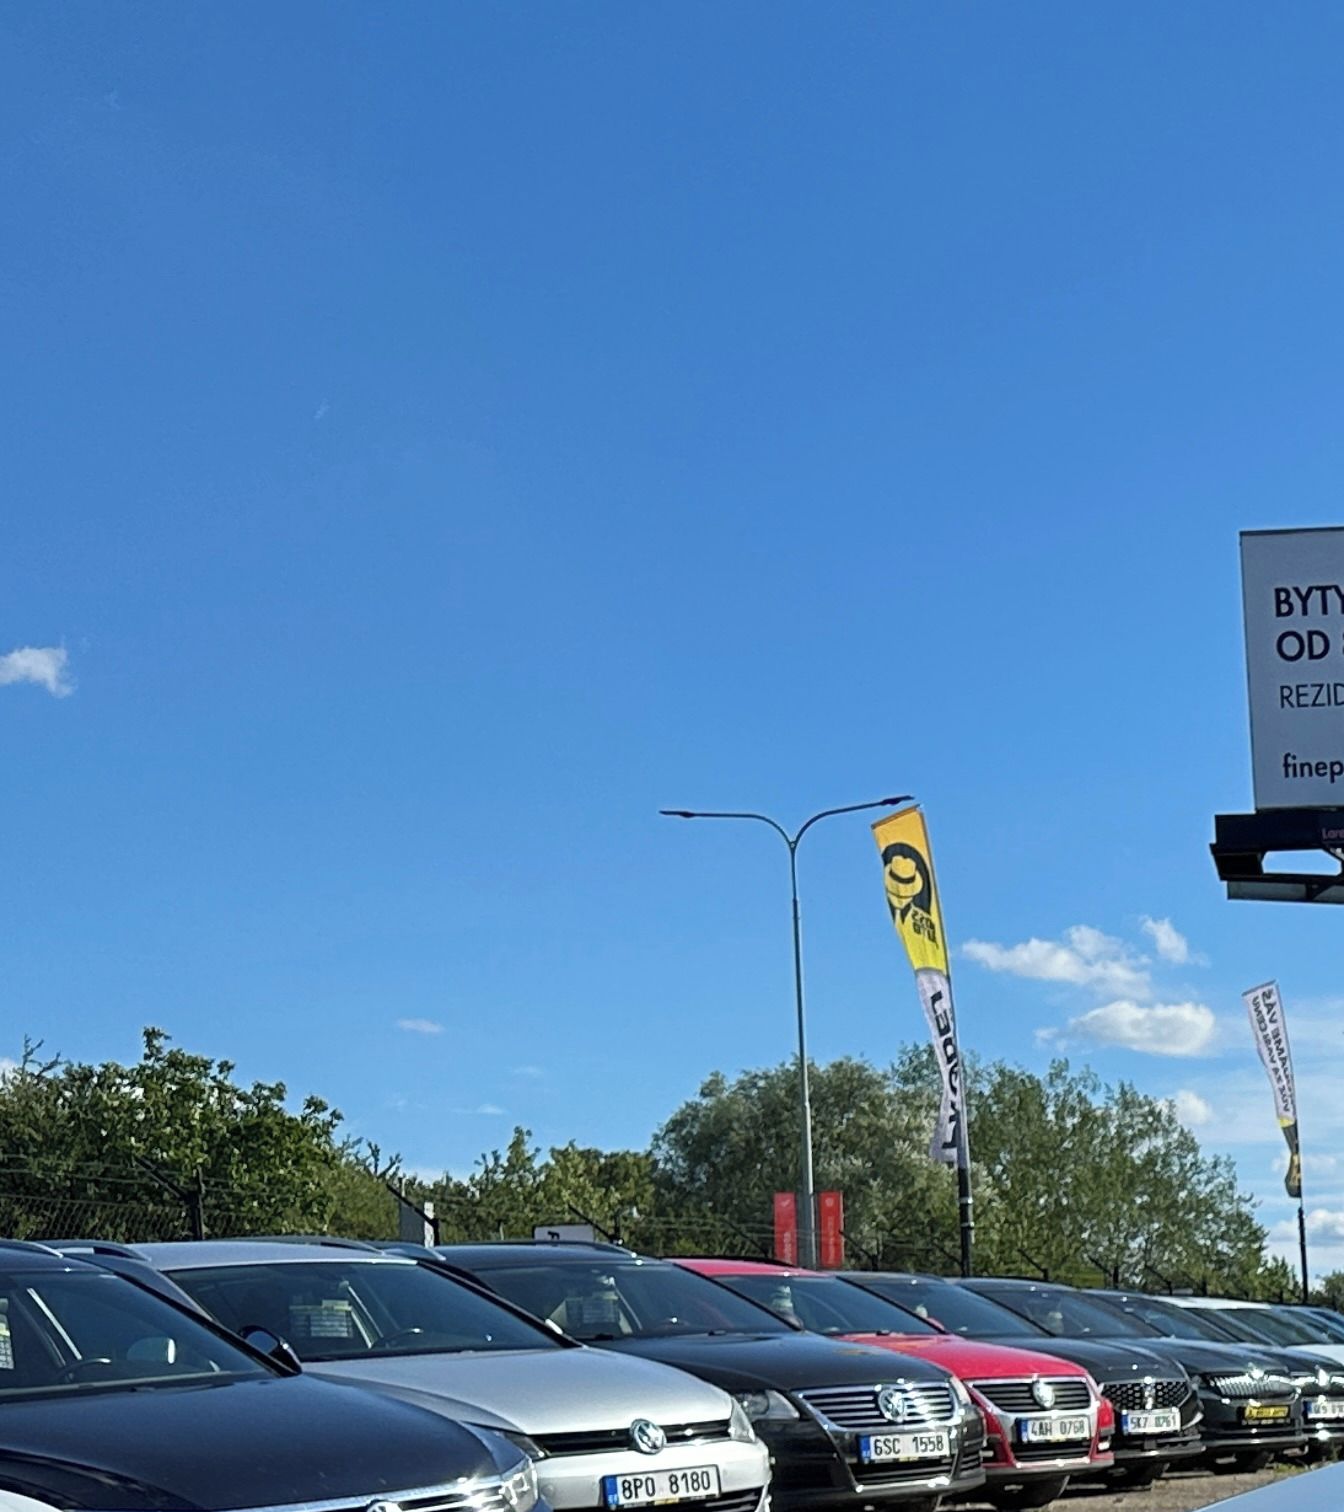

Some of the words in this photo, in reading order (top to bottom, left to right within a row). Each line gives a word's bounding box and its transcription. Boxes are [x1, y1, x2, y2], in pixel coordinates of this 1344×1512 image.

[1276, 630, 1330, 662] OD
[873, 1438, 901, 1456] 6SC
[913, 1435, 944, 1453] 1558
[622, 1477, 656, 1499] 8P0
[668, 1471, 711, 1494] 8180
